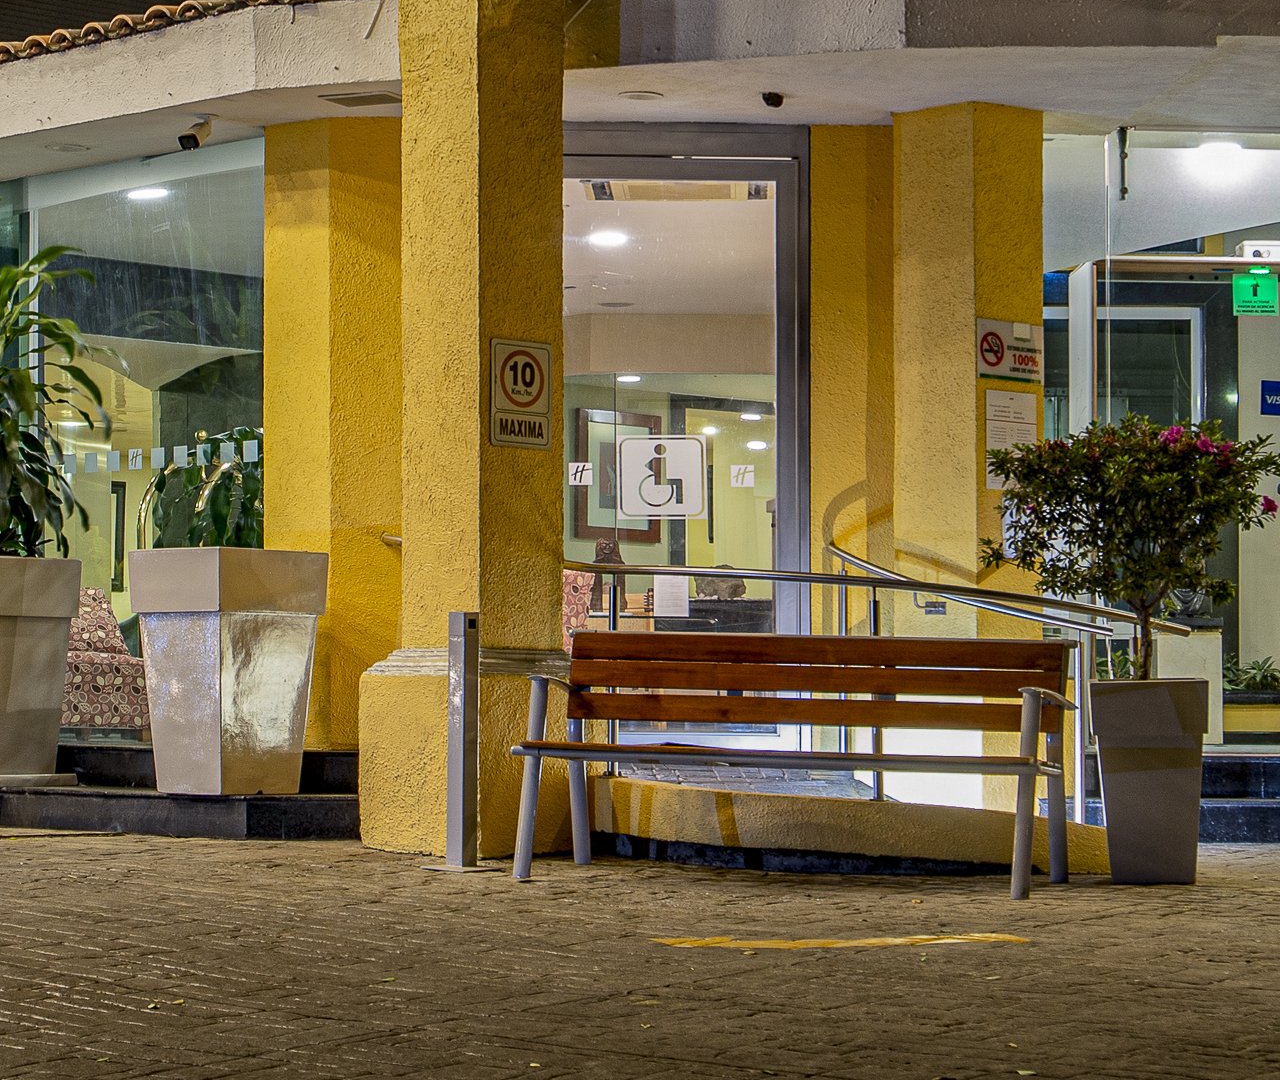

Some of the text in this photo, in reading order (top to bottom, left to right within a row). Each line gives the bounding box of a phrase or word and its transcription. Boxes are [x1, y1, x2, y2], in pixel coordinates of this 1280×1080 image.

[1012, 353, 1039, 368] 100%
[509, 360, 535, 388] 10
[499, 418, 544, 440] MAXIMA
[571, 464, 592, 483] H
[733, 466, 754, 485] H
